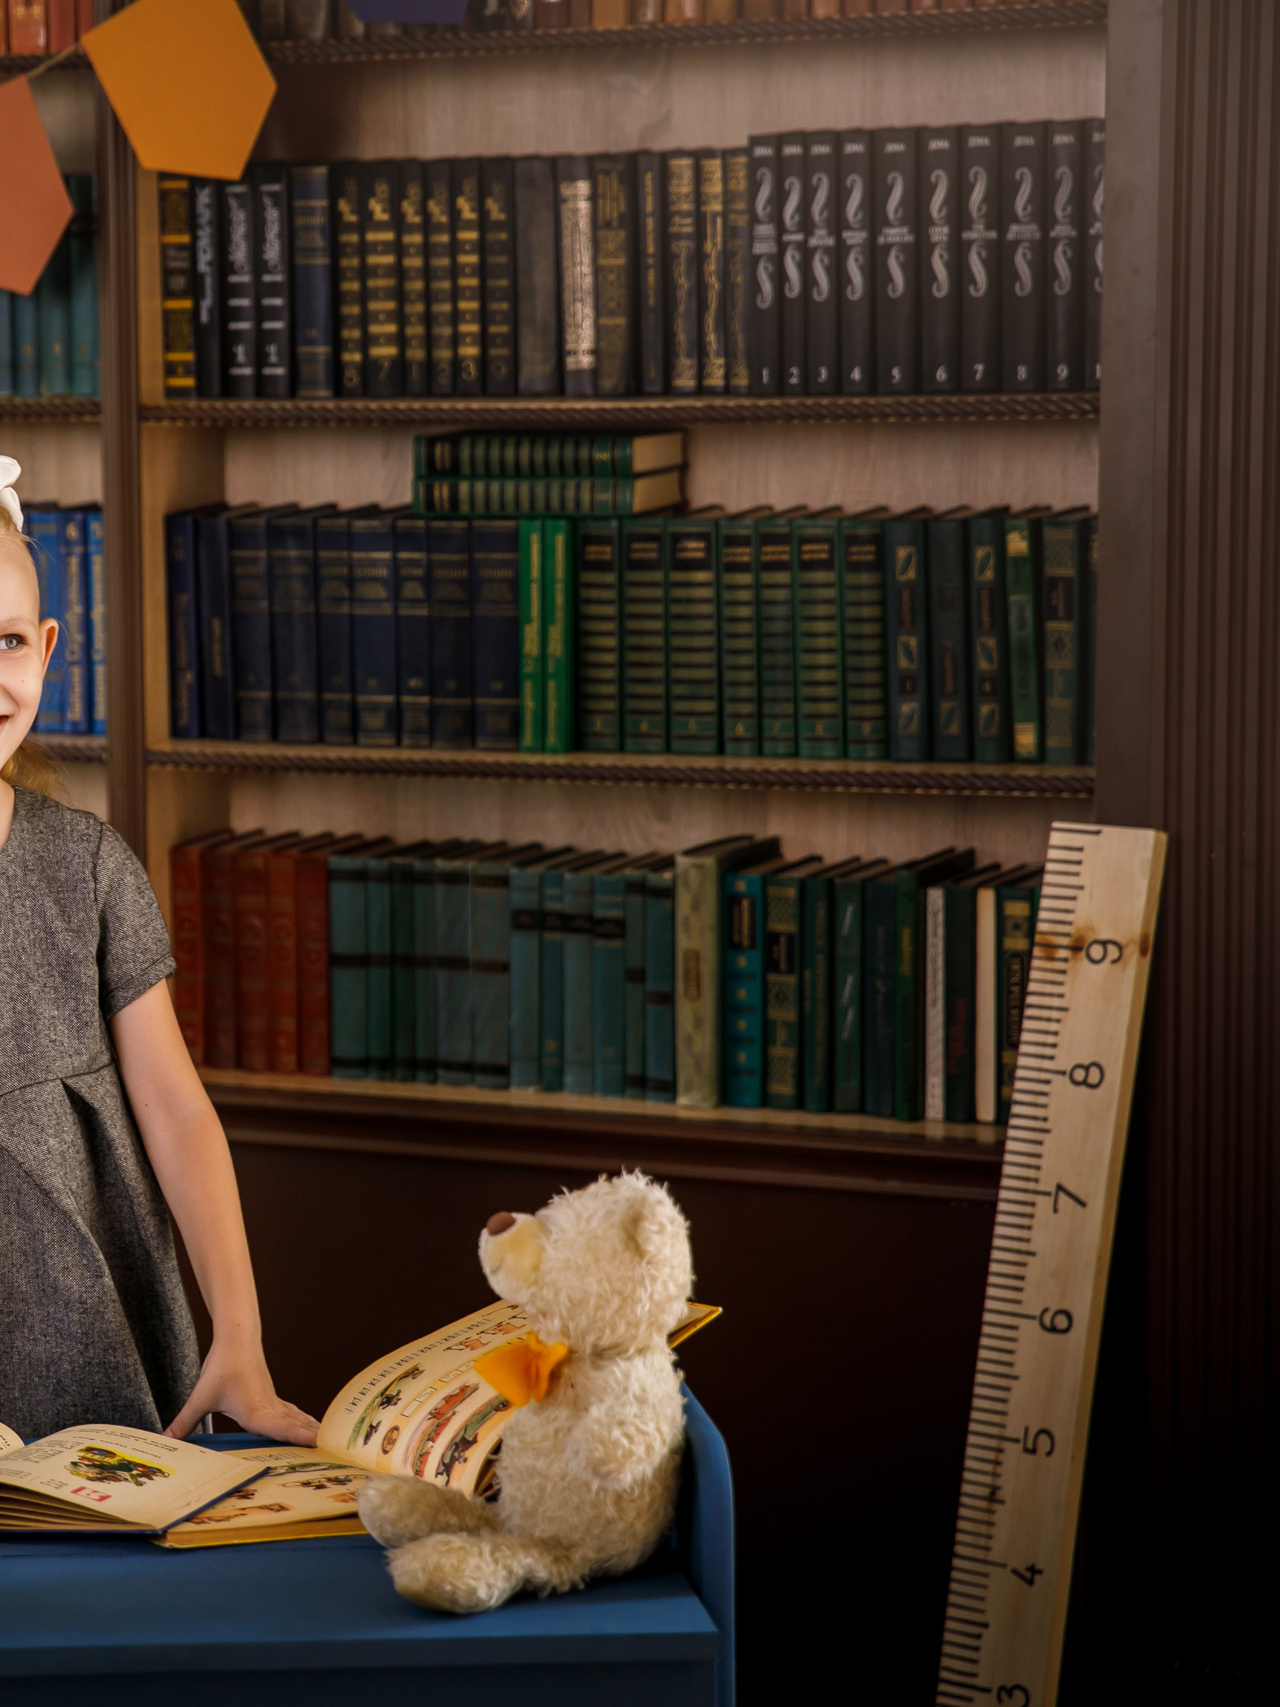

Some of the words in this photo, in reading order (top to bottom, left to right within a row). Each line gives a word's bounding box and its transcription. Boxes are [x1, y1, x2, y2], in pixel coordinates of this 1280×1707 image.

[460, 357, 477, 382] 3
[762, 366, 770, 384] 1
[788, 366, 801, 384] 2
[817, 366, 829, 383] 3
[849, 365, 862, 382] 4
[891, 366, 902, 383] 5
[936, 364, 948, 383] 6
[973, 363, 985, 381] 7
[1016, 363, 1029, 381] 8
[1057, 362, 1069, 381] 9
[1084, 938, 1124, 965] 9
[1068, 1061, 1105, 1090] 8
[1052, 1182, 1088, 1214] 7
[1037, 1306, 1074, 1336] 6
[1022, 1425, 1056, 1457] 5
[1010, 1562, 1044, 1588] 4
[996, 1682, 1030, 1707] 3
